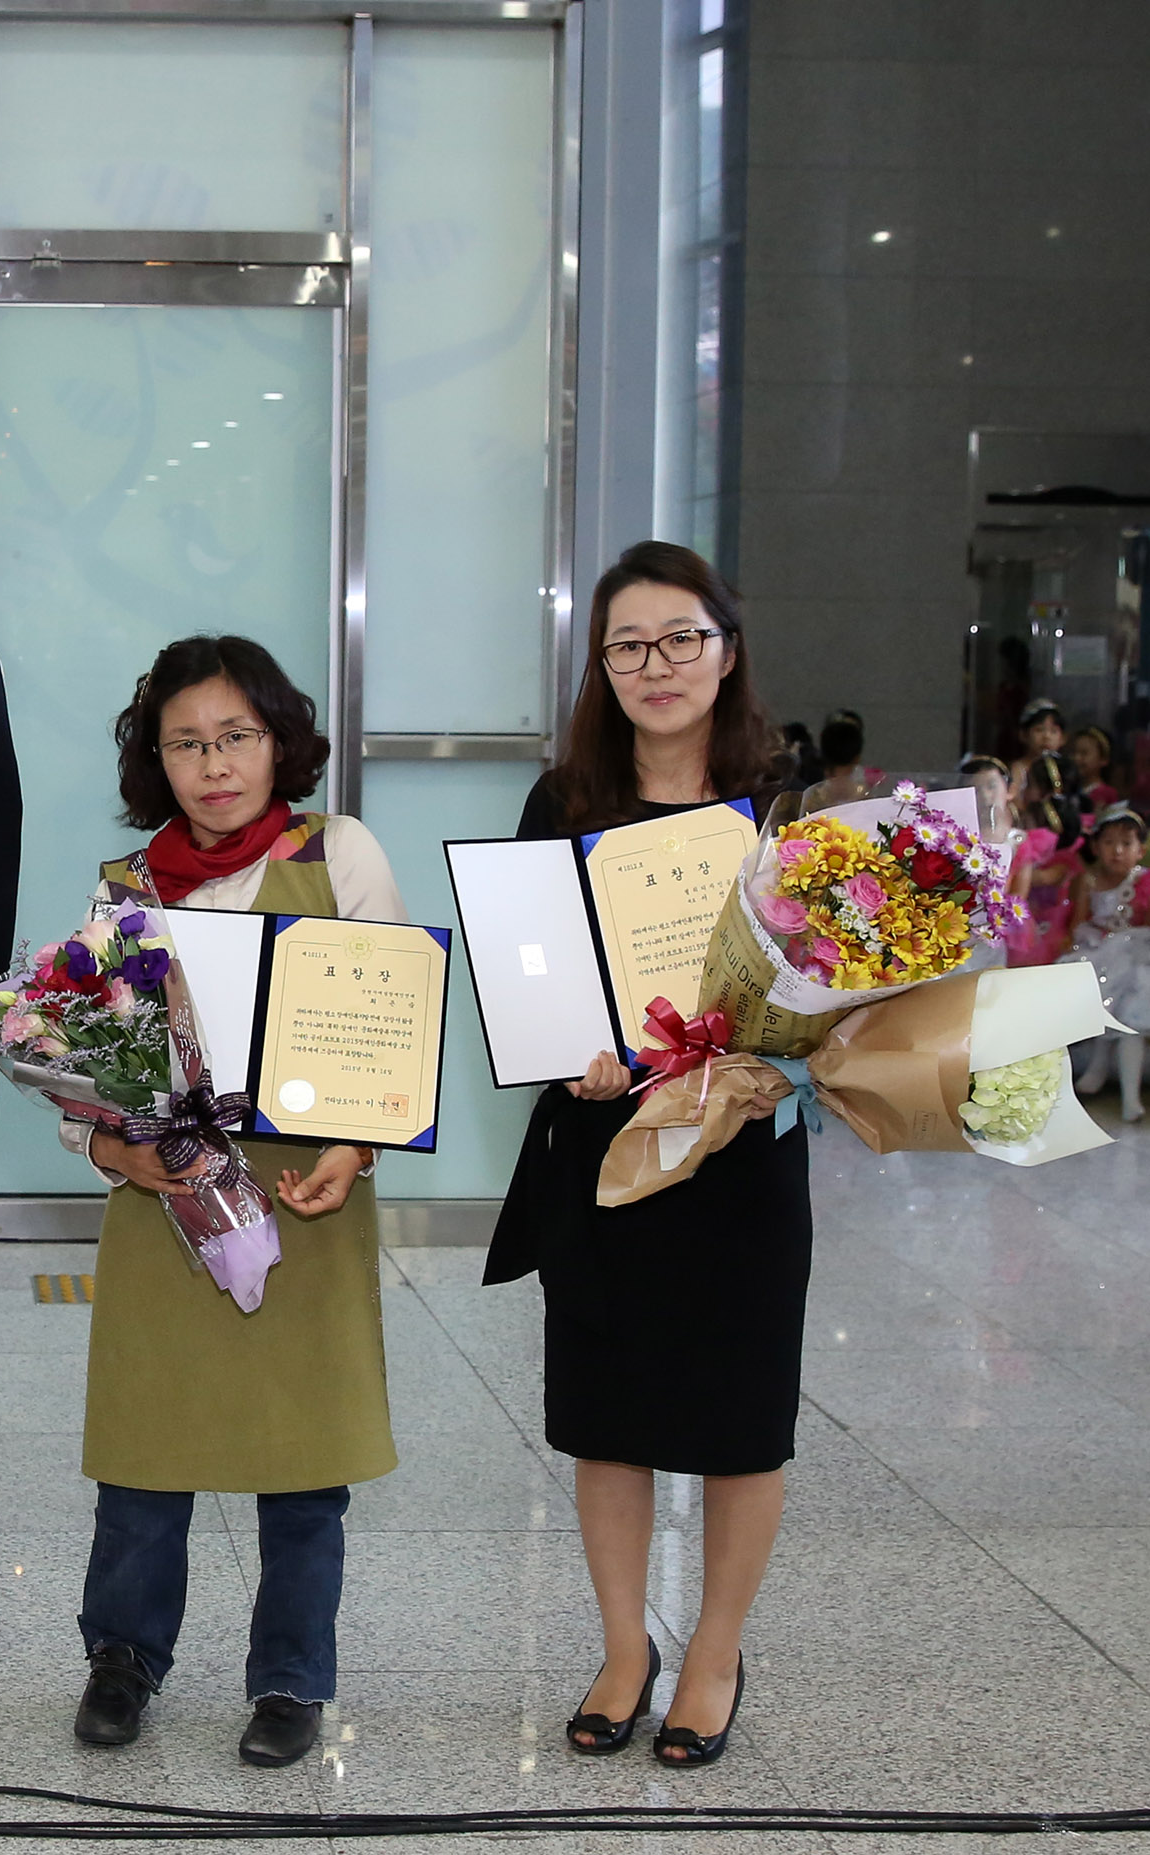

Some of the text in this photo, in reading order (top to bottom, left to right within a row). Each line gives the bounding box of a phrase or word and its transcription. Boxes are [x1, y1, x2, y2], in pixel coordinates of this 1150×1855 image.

[645, 861, 711, 887] 표 창 장
[725, 941, 741, 970] Lui
[324, 966, 392, 983] 표 창 장
[764, 1005, 783, 1025] Je
